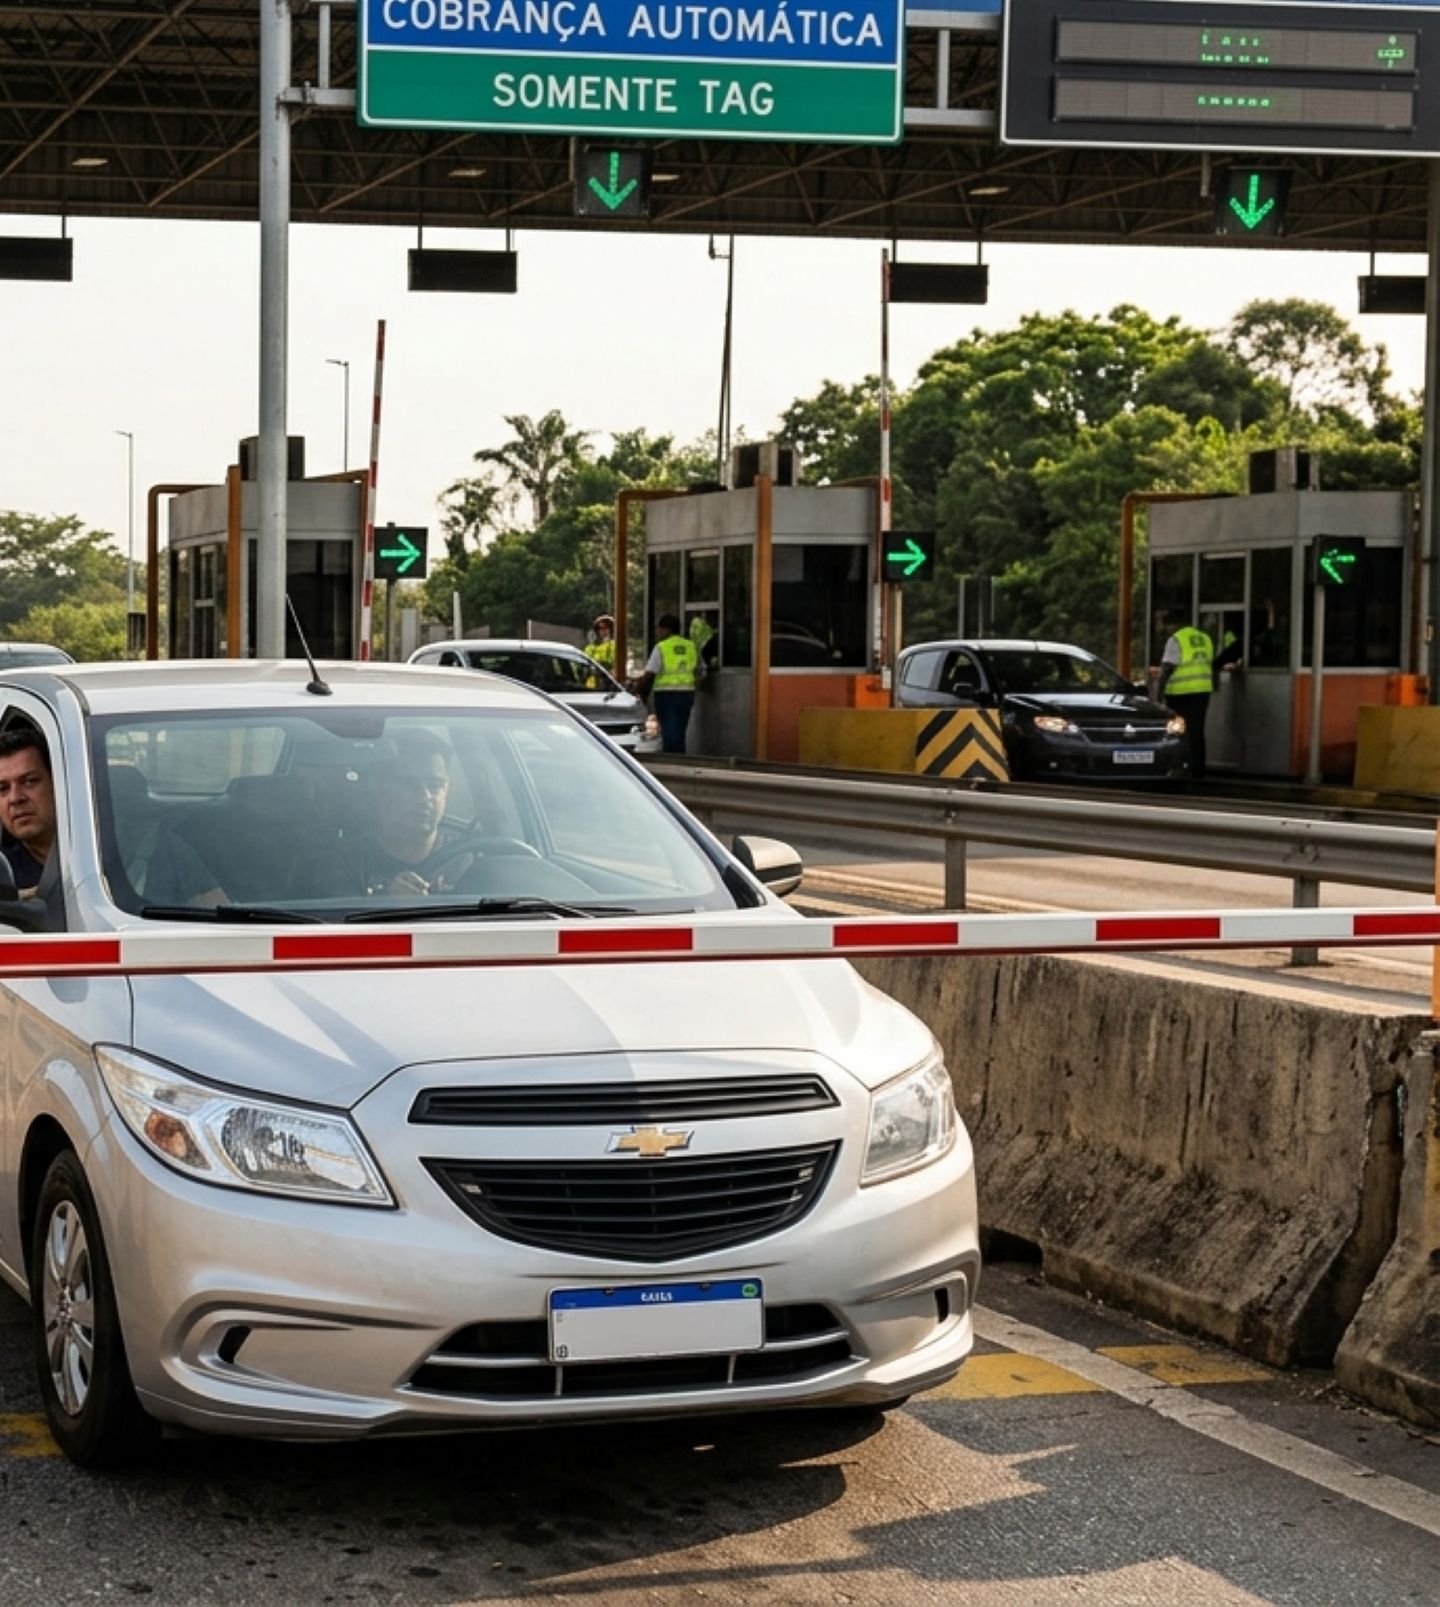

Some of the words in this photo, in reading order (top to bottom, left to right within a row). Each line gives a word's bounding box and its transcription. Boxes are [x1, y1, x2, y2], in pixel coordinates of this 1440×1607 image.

[382, 0, 607, 43] COBRANÇA
[627, 1, 883, 47] AUTOMÁTICA
[492, 73, 677, 113] SOMENTE
[699, 80, 775, 116] TAG
